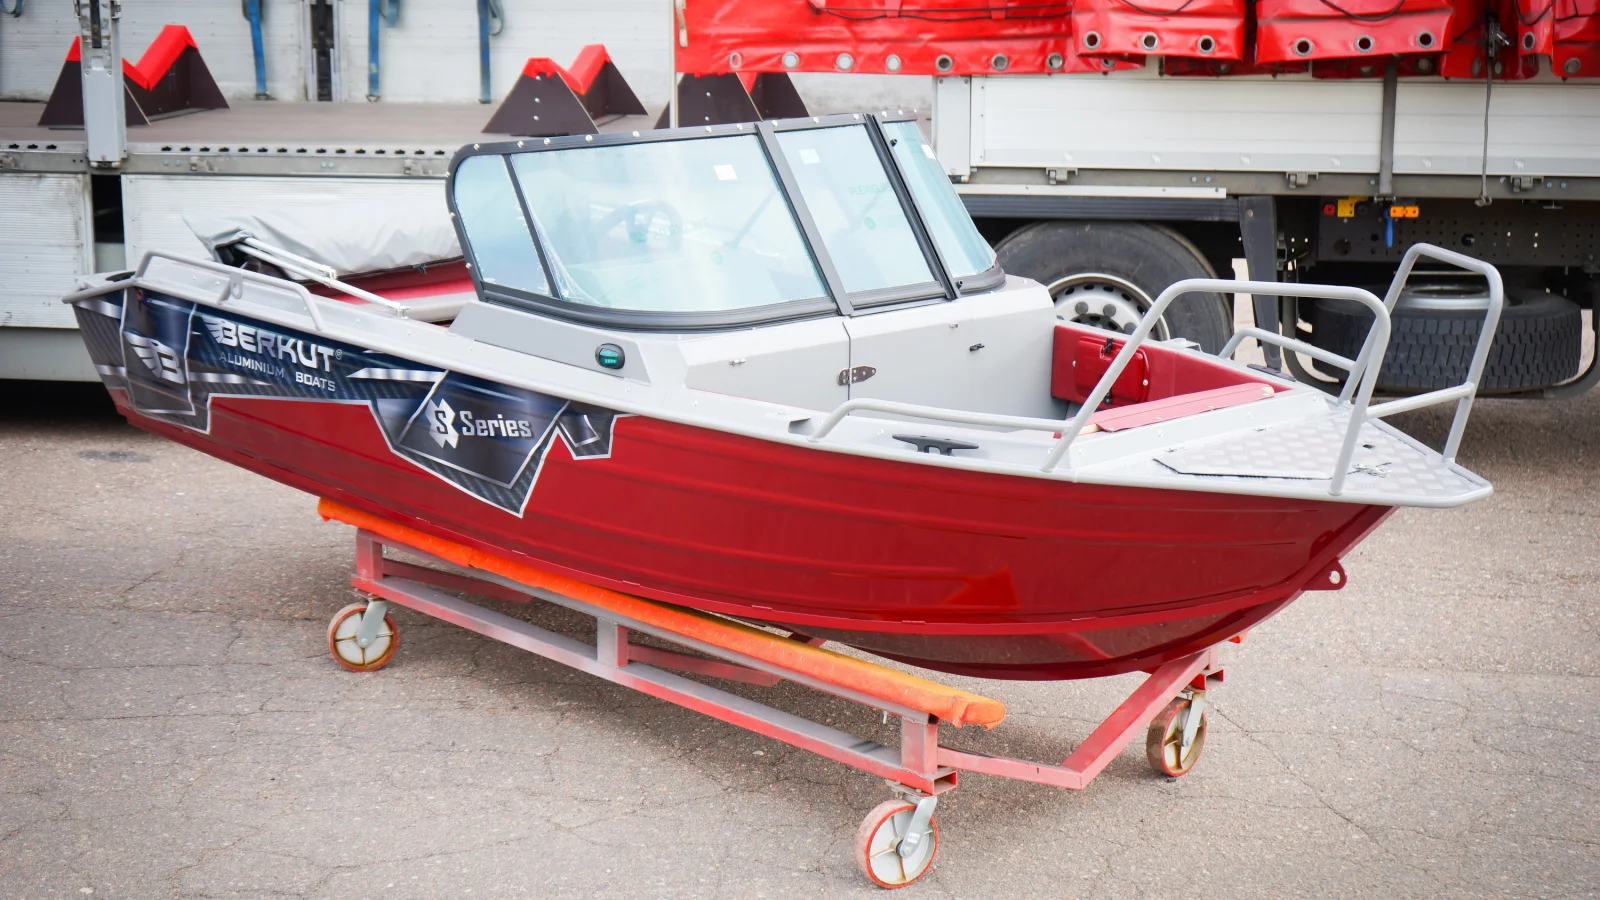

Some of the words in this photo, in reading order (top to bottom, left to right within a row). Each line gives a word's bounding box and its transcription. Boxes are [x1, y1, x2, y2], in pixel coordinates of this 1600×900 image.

[219, 351, 285, 378] ALUMINIUM
[295, 371, 336, 392] BOATS
[459, 410, 533, 438] Series
